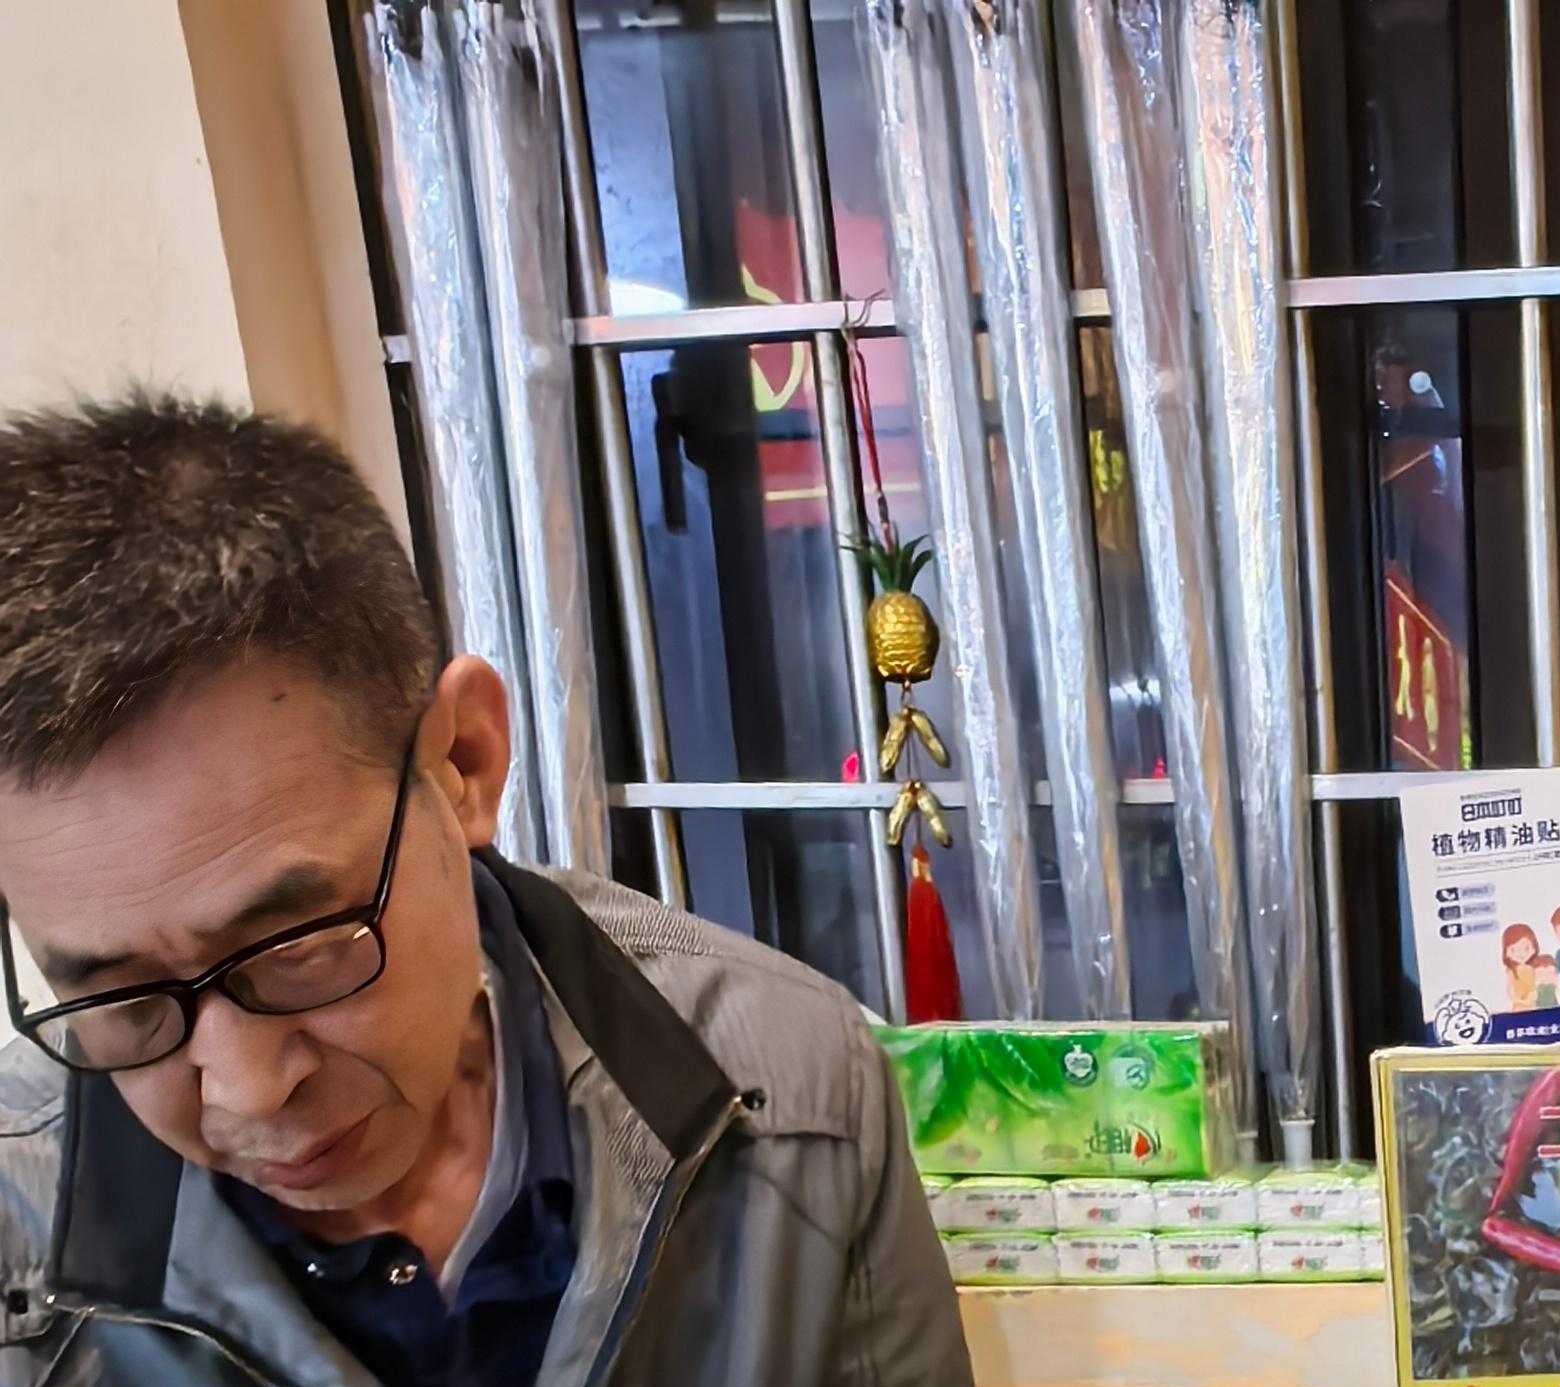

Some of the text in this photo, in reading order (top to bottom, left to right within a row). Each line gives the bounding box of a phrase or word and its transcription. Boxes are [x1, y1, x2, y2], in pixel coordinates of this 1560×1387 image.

[1431, 818, 1560, 857] 植物精油贴
